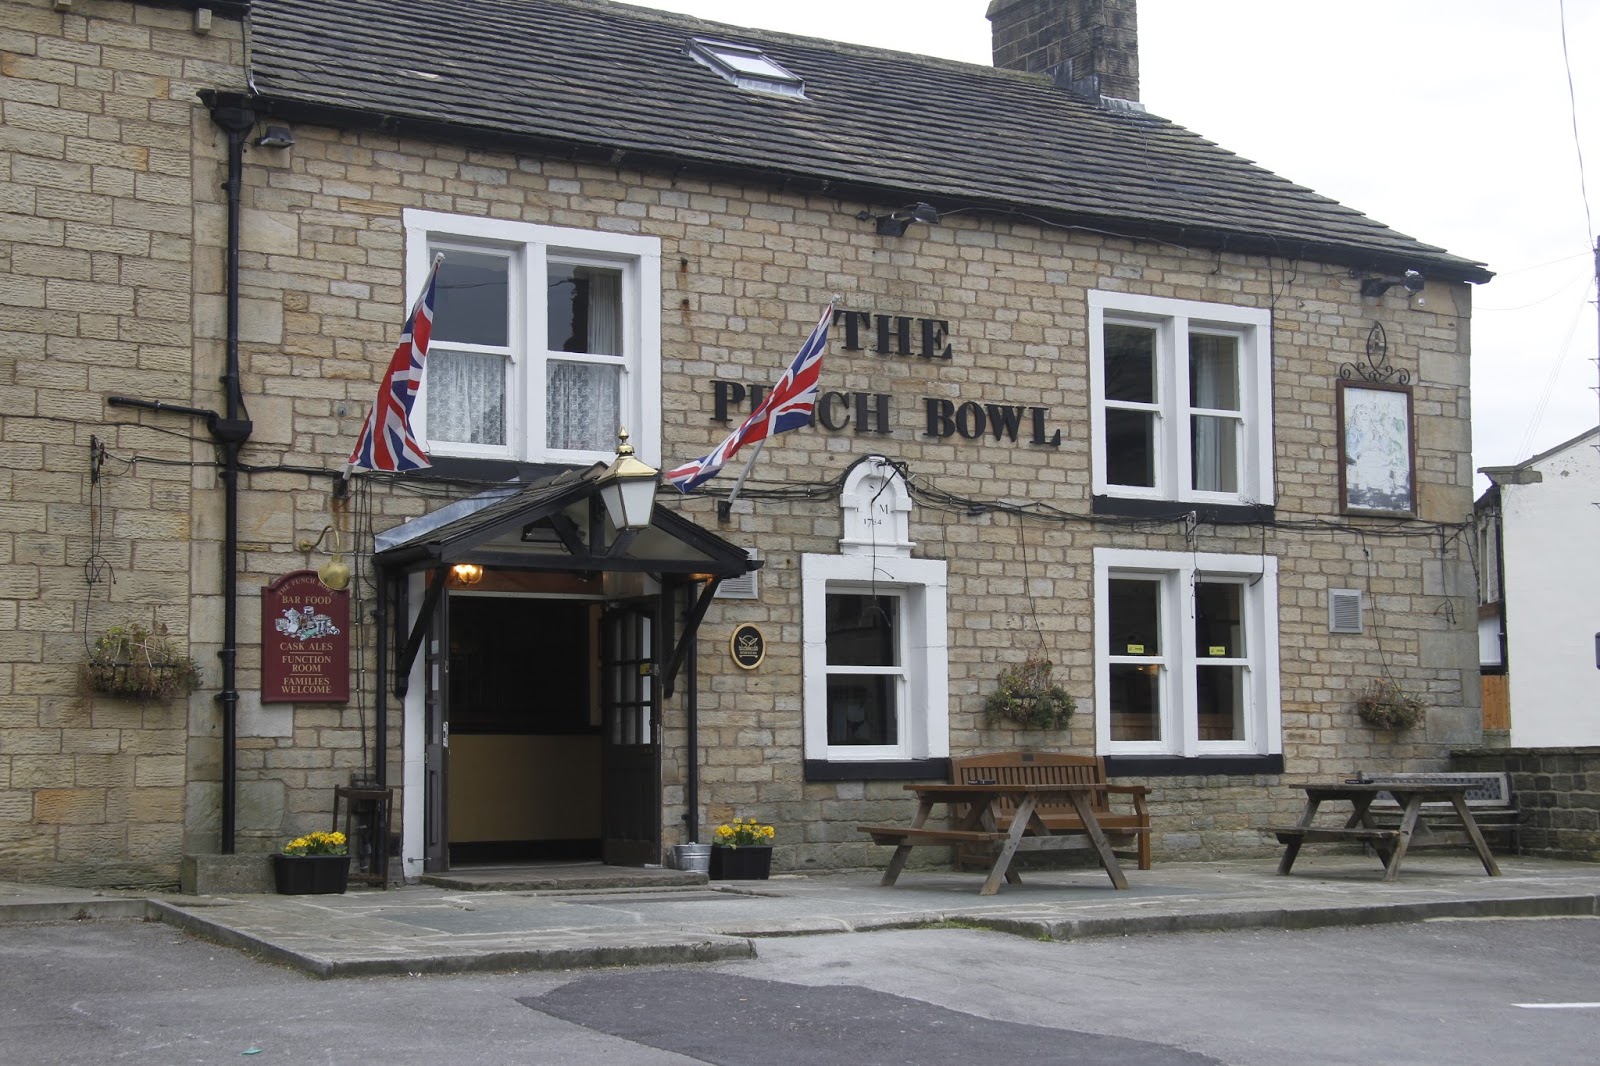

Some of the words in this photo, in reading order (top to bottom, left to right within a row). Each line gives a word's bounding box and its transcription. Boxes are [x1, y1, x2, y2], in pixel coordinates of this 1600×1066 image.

[833, 309, 952, 359] THE
[710, 379, 893, 434] PCH
[923, 397, 1061, 447] BOWL
[277, 584, 291, 596] THE
[291, 577, 316, 586] PUNCH
[282, 595, 301, 604] BAR
[305, 595, 332, 605] FOOD
[279, 642, 305, 651] CASK
[308, 642, 333, 651] ALES
[282, 655, 332, 664] FUNCTION
[292, 663, 321, 672] ROOM
[283, 677, 330, 686] FAMILIES
[281, 685, 332, 694] WELCOME
